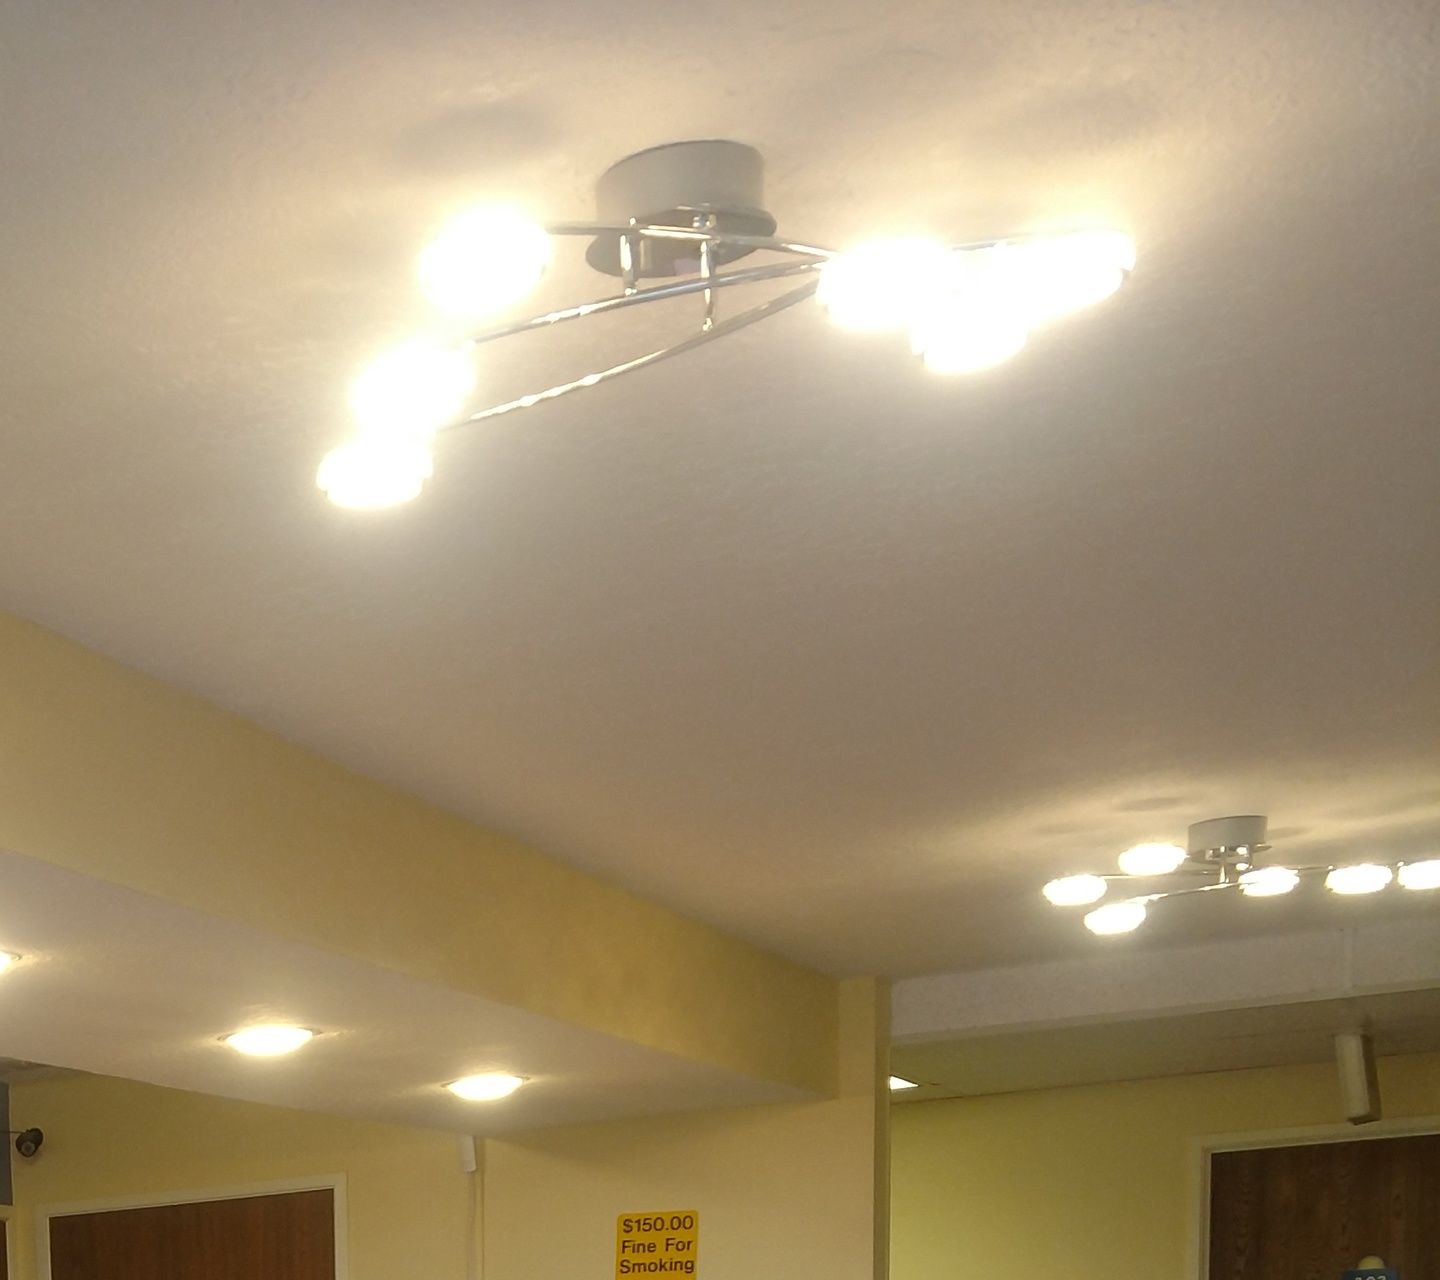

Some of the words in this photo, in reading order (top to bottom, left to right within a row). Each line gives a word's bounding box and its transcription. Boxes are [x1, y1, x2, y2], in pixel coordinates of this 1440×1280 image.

[622, 1215, 694, 1234] $150.00
[621, 1239, 657, 1254] Fine
[665, 1238, 693, 1252] For
[619, 1258, 695, 1274] Smoking
